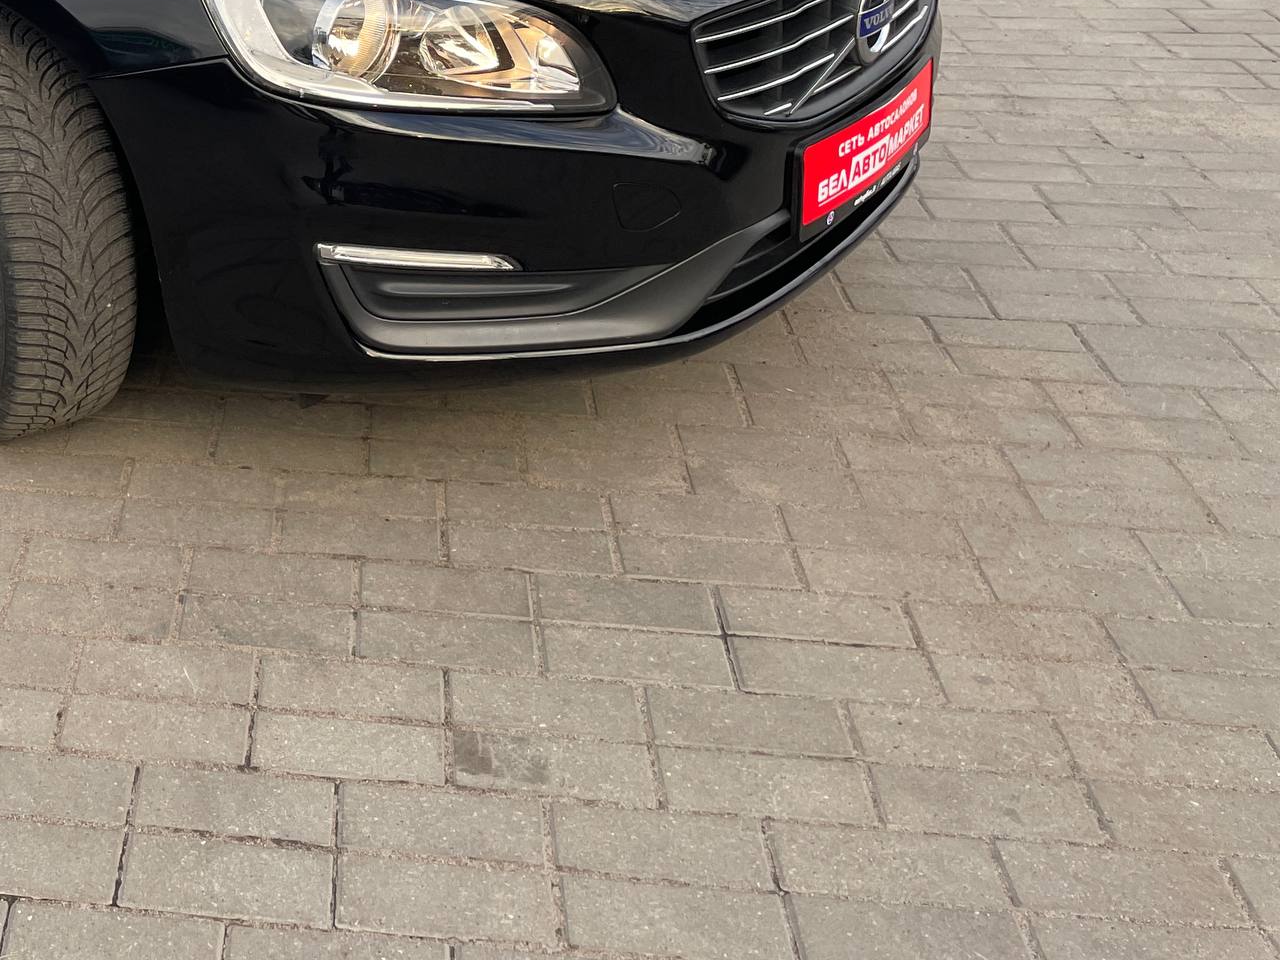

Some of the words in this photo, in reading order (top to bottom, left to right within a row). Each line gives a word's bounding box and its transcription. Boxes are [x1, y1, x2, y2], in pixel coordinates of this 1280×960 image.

[863, 6, 894, 30] VOLV
[817, 103, 925, 204] БЕЛАВТОМАРКЕТ
[837, 134, 866, 158] СЕТЬ
[866, 87, 919, 142] АВТОСАЛОНОВ
